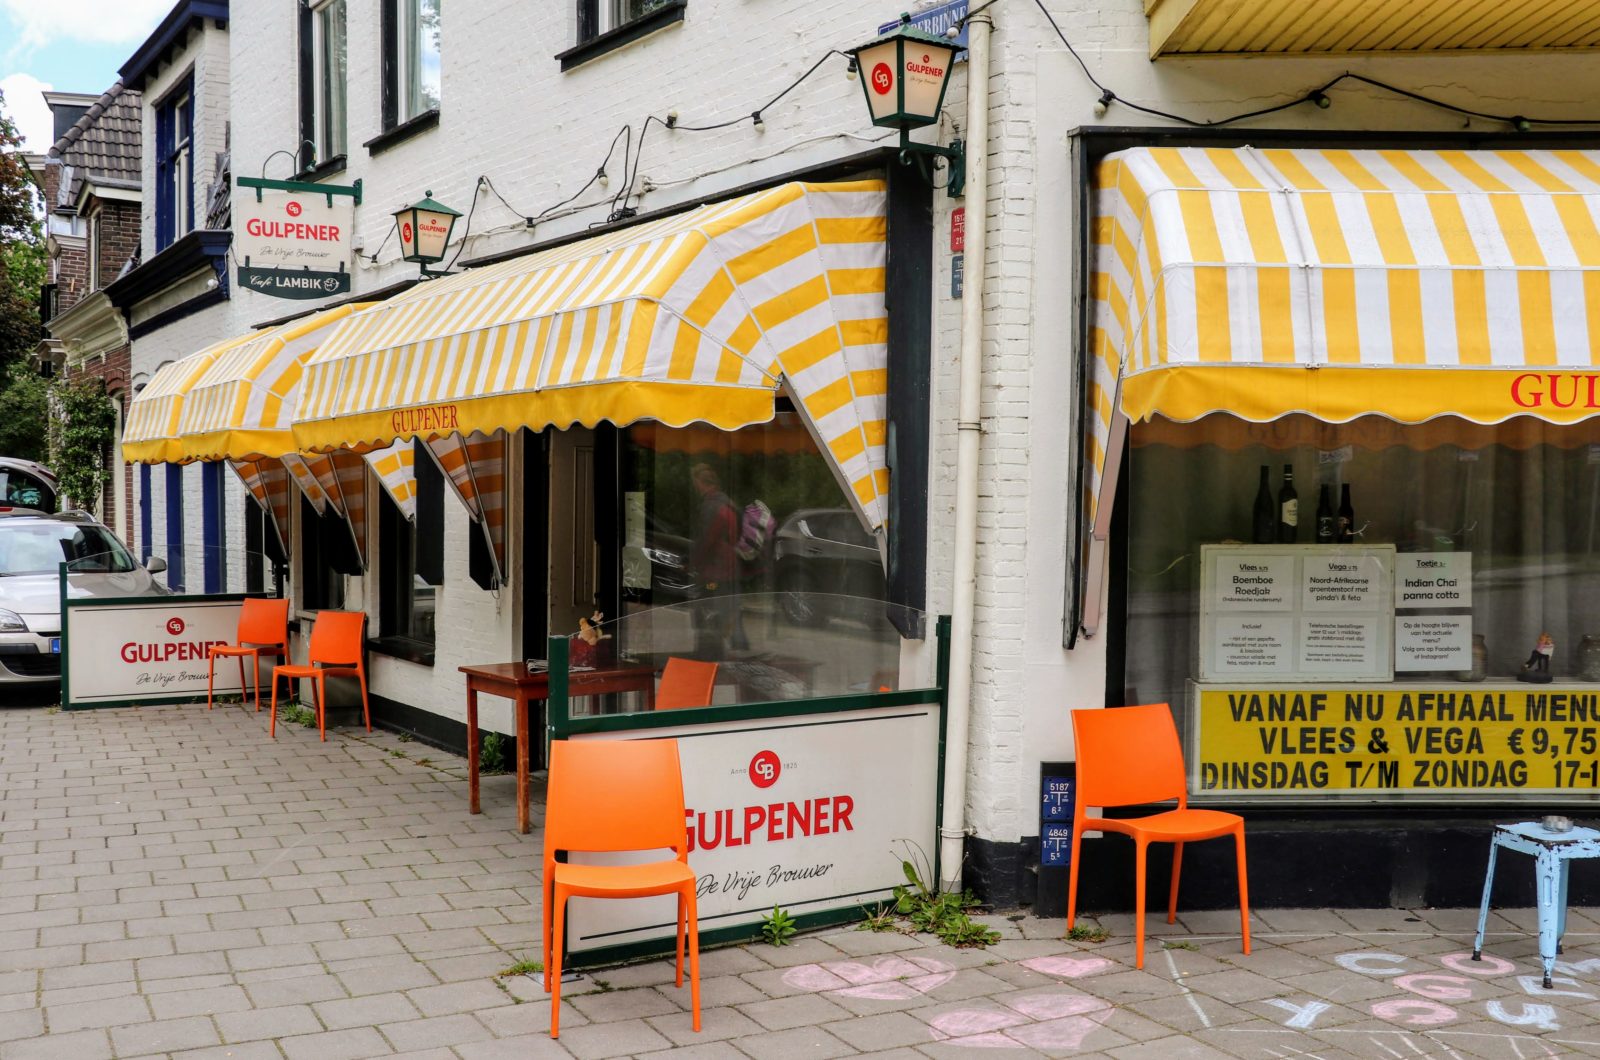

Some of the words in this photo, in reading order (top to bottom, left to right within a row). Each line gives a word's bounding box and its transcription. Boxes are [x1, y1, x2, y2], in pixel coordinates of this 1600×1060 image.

[906, 62, 943, 77] GULPENER
[875, 70, 889, 87] GB
[247, 219, 340, 241] GULPENER
[419, 223, 447, 232] GULPENER
[250, 275, 273, 288] Café
[276, 276, 322, 289] LAMBIK
[392, 405, 459, 433] GULPENER
[1239, 563, 1257, 571] Vlees
[1328, 563, 1347, 571] Vega
[1416, 560, 1438, 568] Toetje
[1232, 576, 1274, 584] Boemboe
[1309, 577, 1369, 585] Noord-Afrikaanse
[1405, 579, 1434, 587] Indian
[1436, 578, 1457, 587] Chai
[1235, 587, 1271, 596] Roedjak
[1403, 592, 1433, 601] panna
[1436, 591, 1460, 599] cotta
[1347, 594, 1362, 602] feta
[169, 620, 181, 632] GB
[121, 640, 229, 664] GULPENER
[136, 672, 151, 685] De
[153, 670, 175, 687] Vrije
[1228, 694, 1328, 722] VANAF
[1345, 694, 1384, 722] NU
[1396, 693, 1514, 722] AFHAAL
[1259, 726, 1355, 754] VLEES
[1368, 727, 1390, 754] &
[1404, 726, 1484, 754] VEGA
[731, 768, 747, 776] Anno
[754, 758, 775, 780] GB
[1201, 761, 1329, 790] DINSDAG
[1345, 760, 1399, 789] T/M
[1413, 759, 1528, 788] ZONDAG
[1554, 760, 1599, 788] 17-1
[1050, 783, 1069, 791] 5187
[1048, 829, 1068, 837] 4849
[696, 873, 719, 899] De
[722, 871, 761, 900] Vrije
[766, 863, 834, 888] Brouwer
